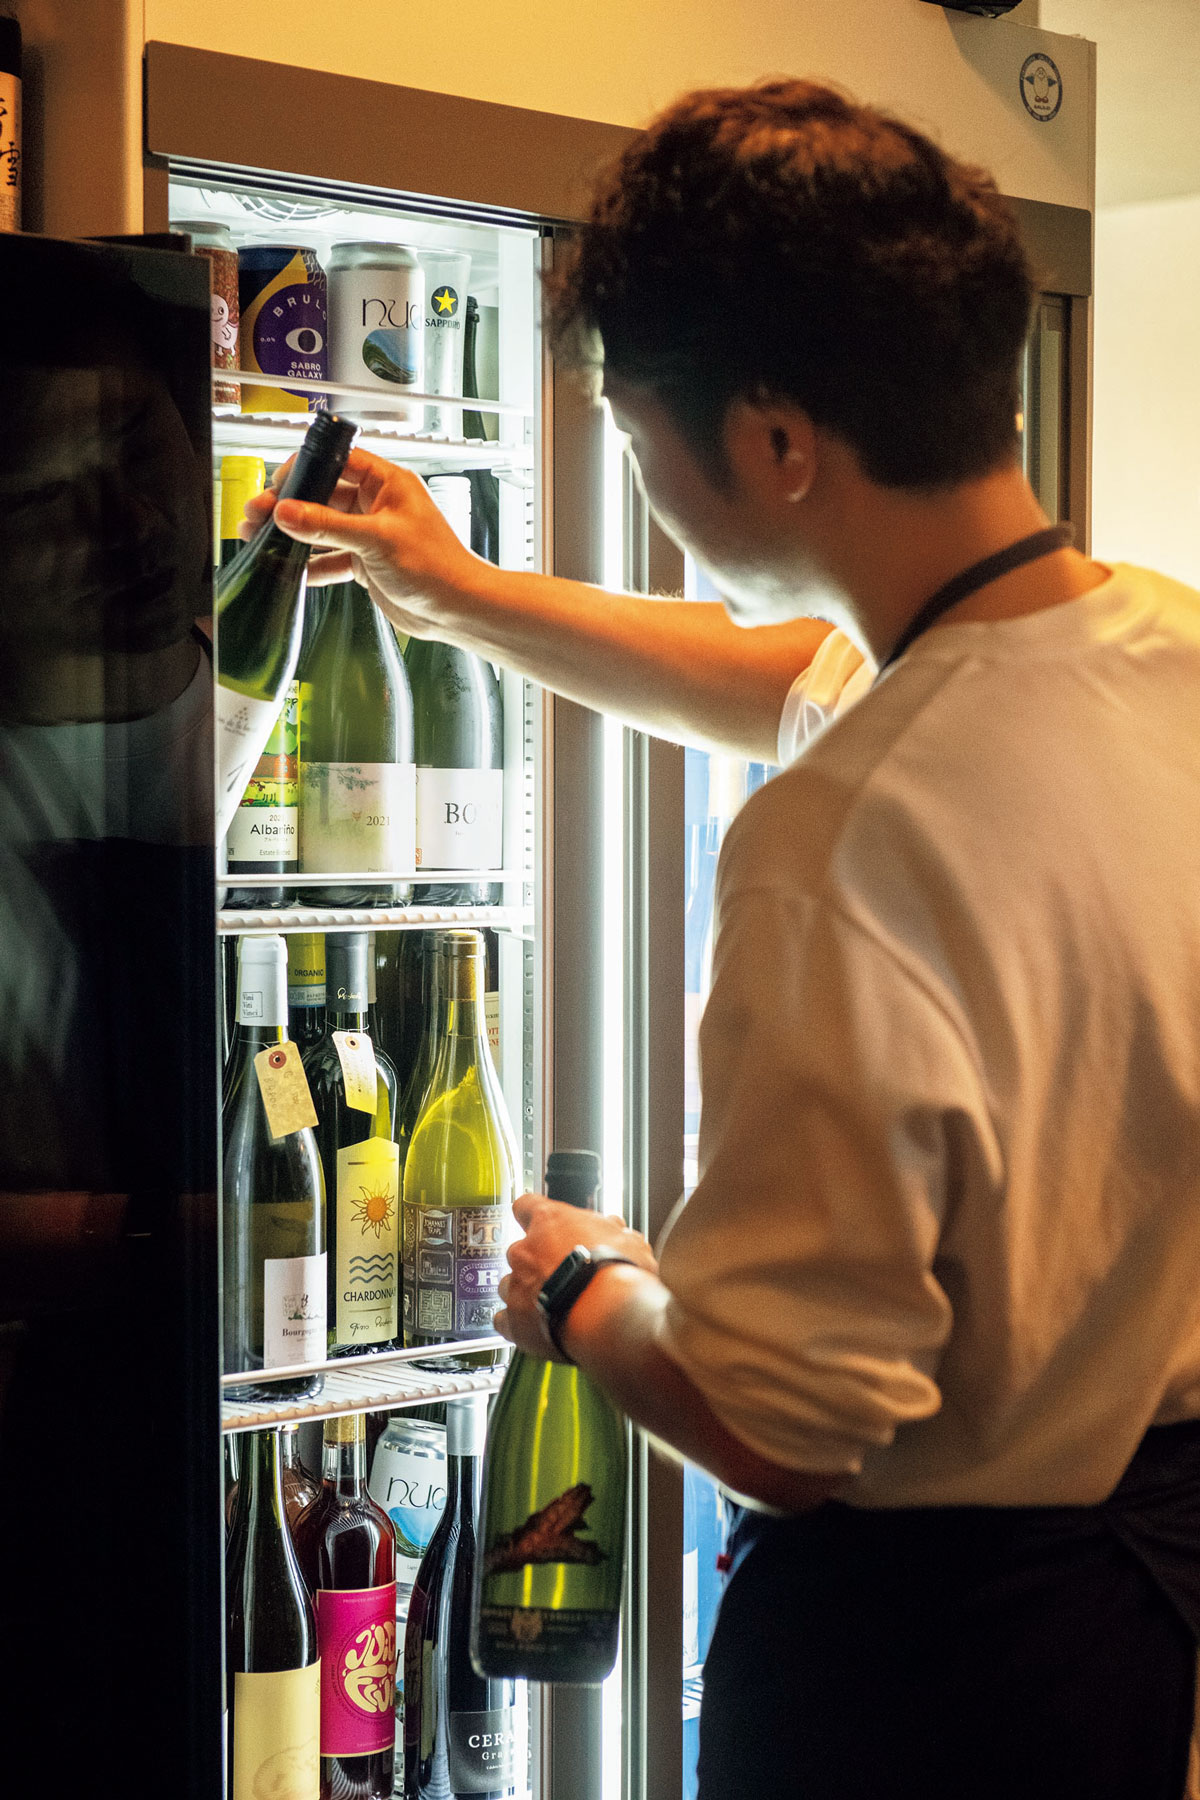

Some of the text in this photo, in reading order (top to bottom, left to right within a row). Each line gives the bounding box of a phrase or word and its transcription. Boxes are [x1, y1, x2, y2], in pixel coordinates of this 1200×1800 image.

[425, 318, 460, 330] SAPPORO
[291, 361, 321, 371] SABRO
[287, 370, 323, 379] GALAXY
[366, 816, 391, 826] 2021
[250, 824, 295, 835] Albariño
[294, 969, 324, 977] ORGANIC
[343, 1287, 396, 1302] CHARDONN
